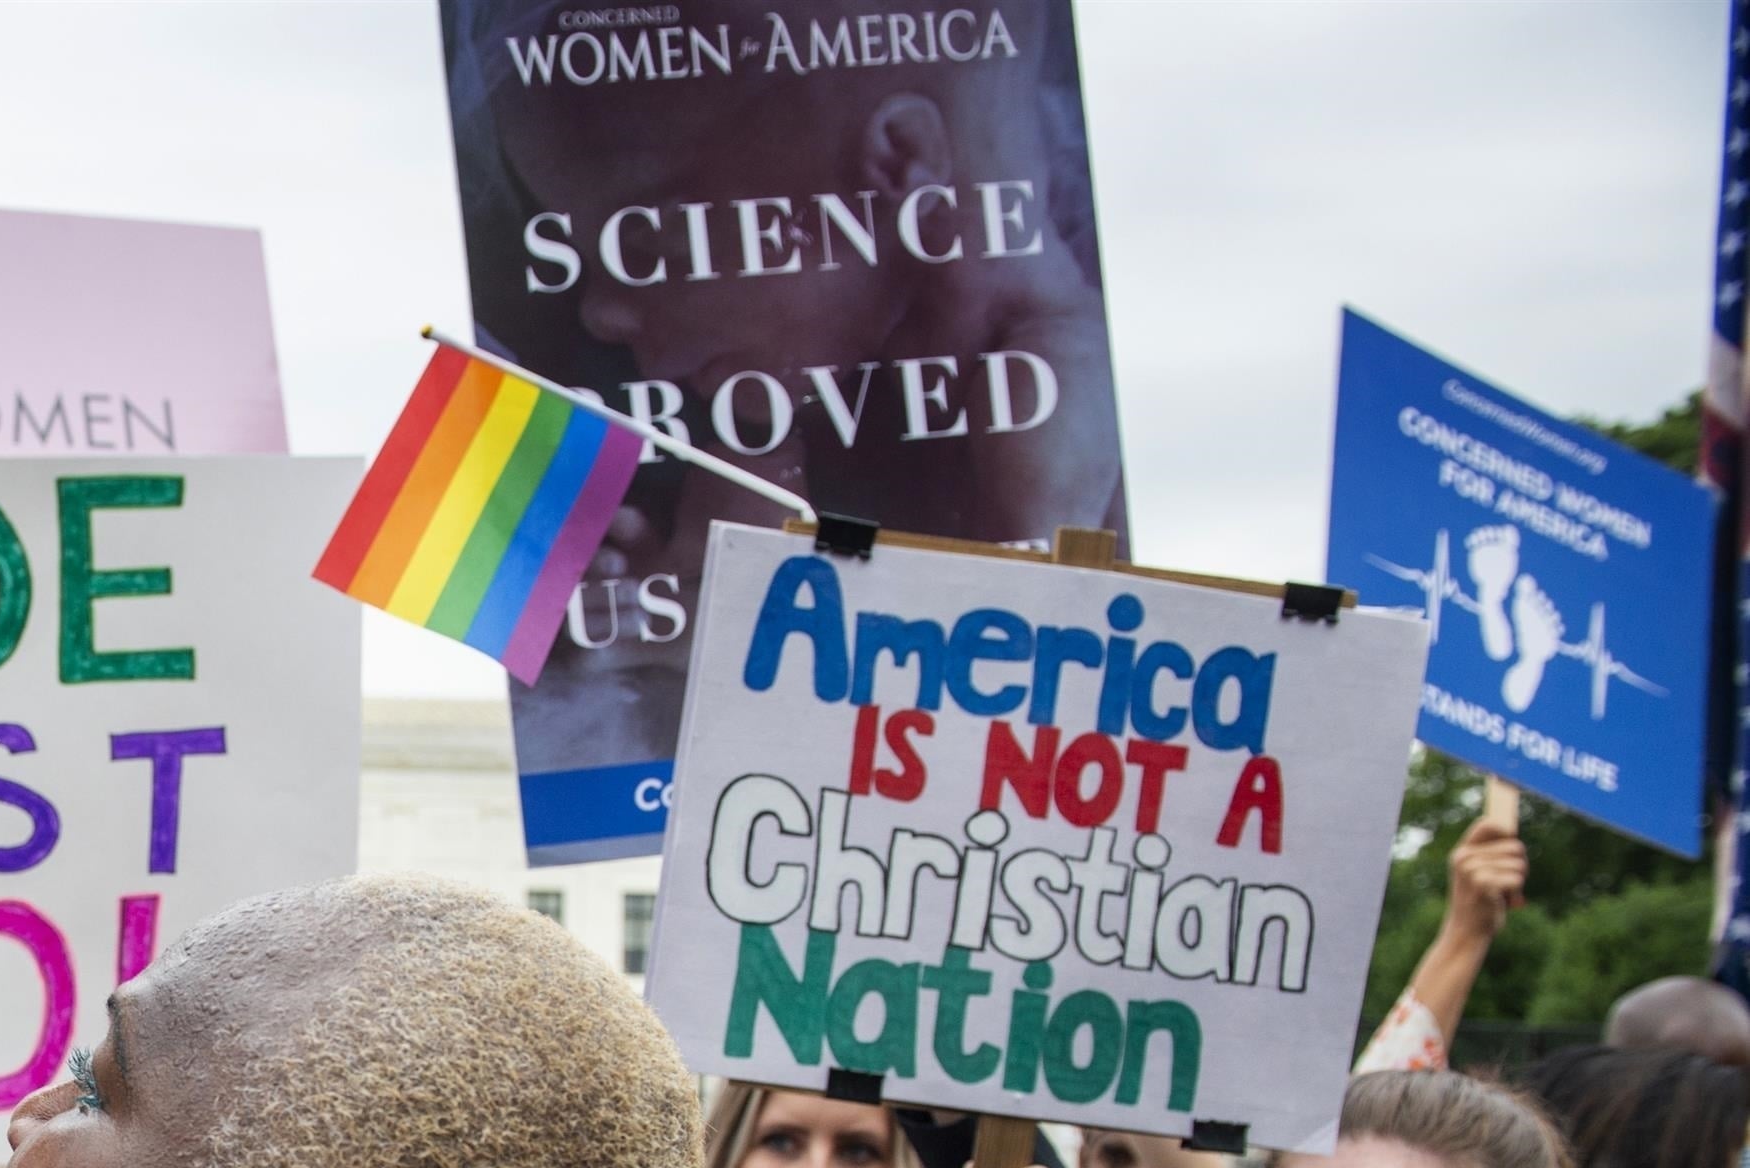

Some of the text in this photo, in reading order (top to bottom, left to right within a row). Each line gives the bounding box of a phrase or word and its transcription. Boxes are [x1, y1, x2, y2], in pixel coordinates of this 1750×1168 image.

[505, 24, 732, 87] WOMEN
[764, 8, 1019, 75] AMERICA
[523, 180, 1045, 294] SCIENCE
[567, 349, 1059, 464] ROVED
[1398, 406, 1652, 549] CONCERNED WOMEN
[1438, 458, 1609, 562] FOR AMERICA
[743, 555, 1277, 754] America
[850, 704, 1284, 855] IS NOT A
[1421, 682, 1619, 792] TANDS FOR LIFE
[706, 773, 1316, 993] Christian
[722, 923, 1203, 1112] Nation
